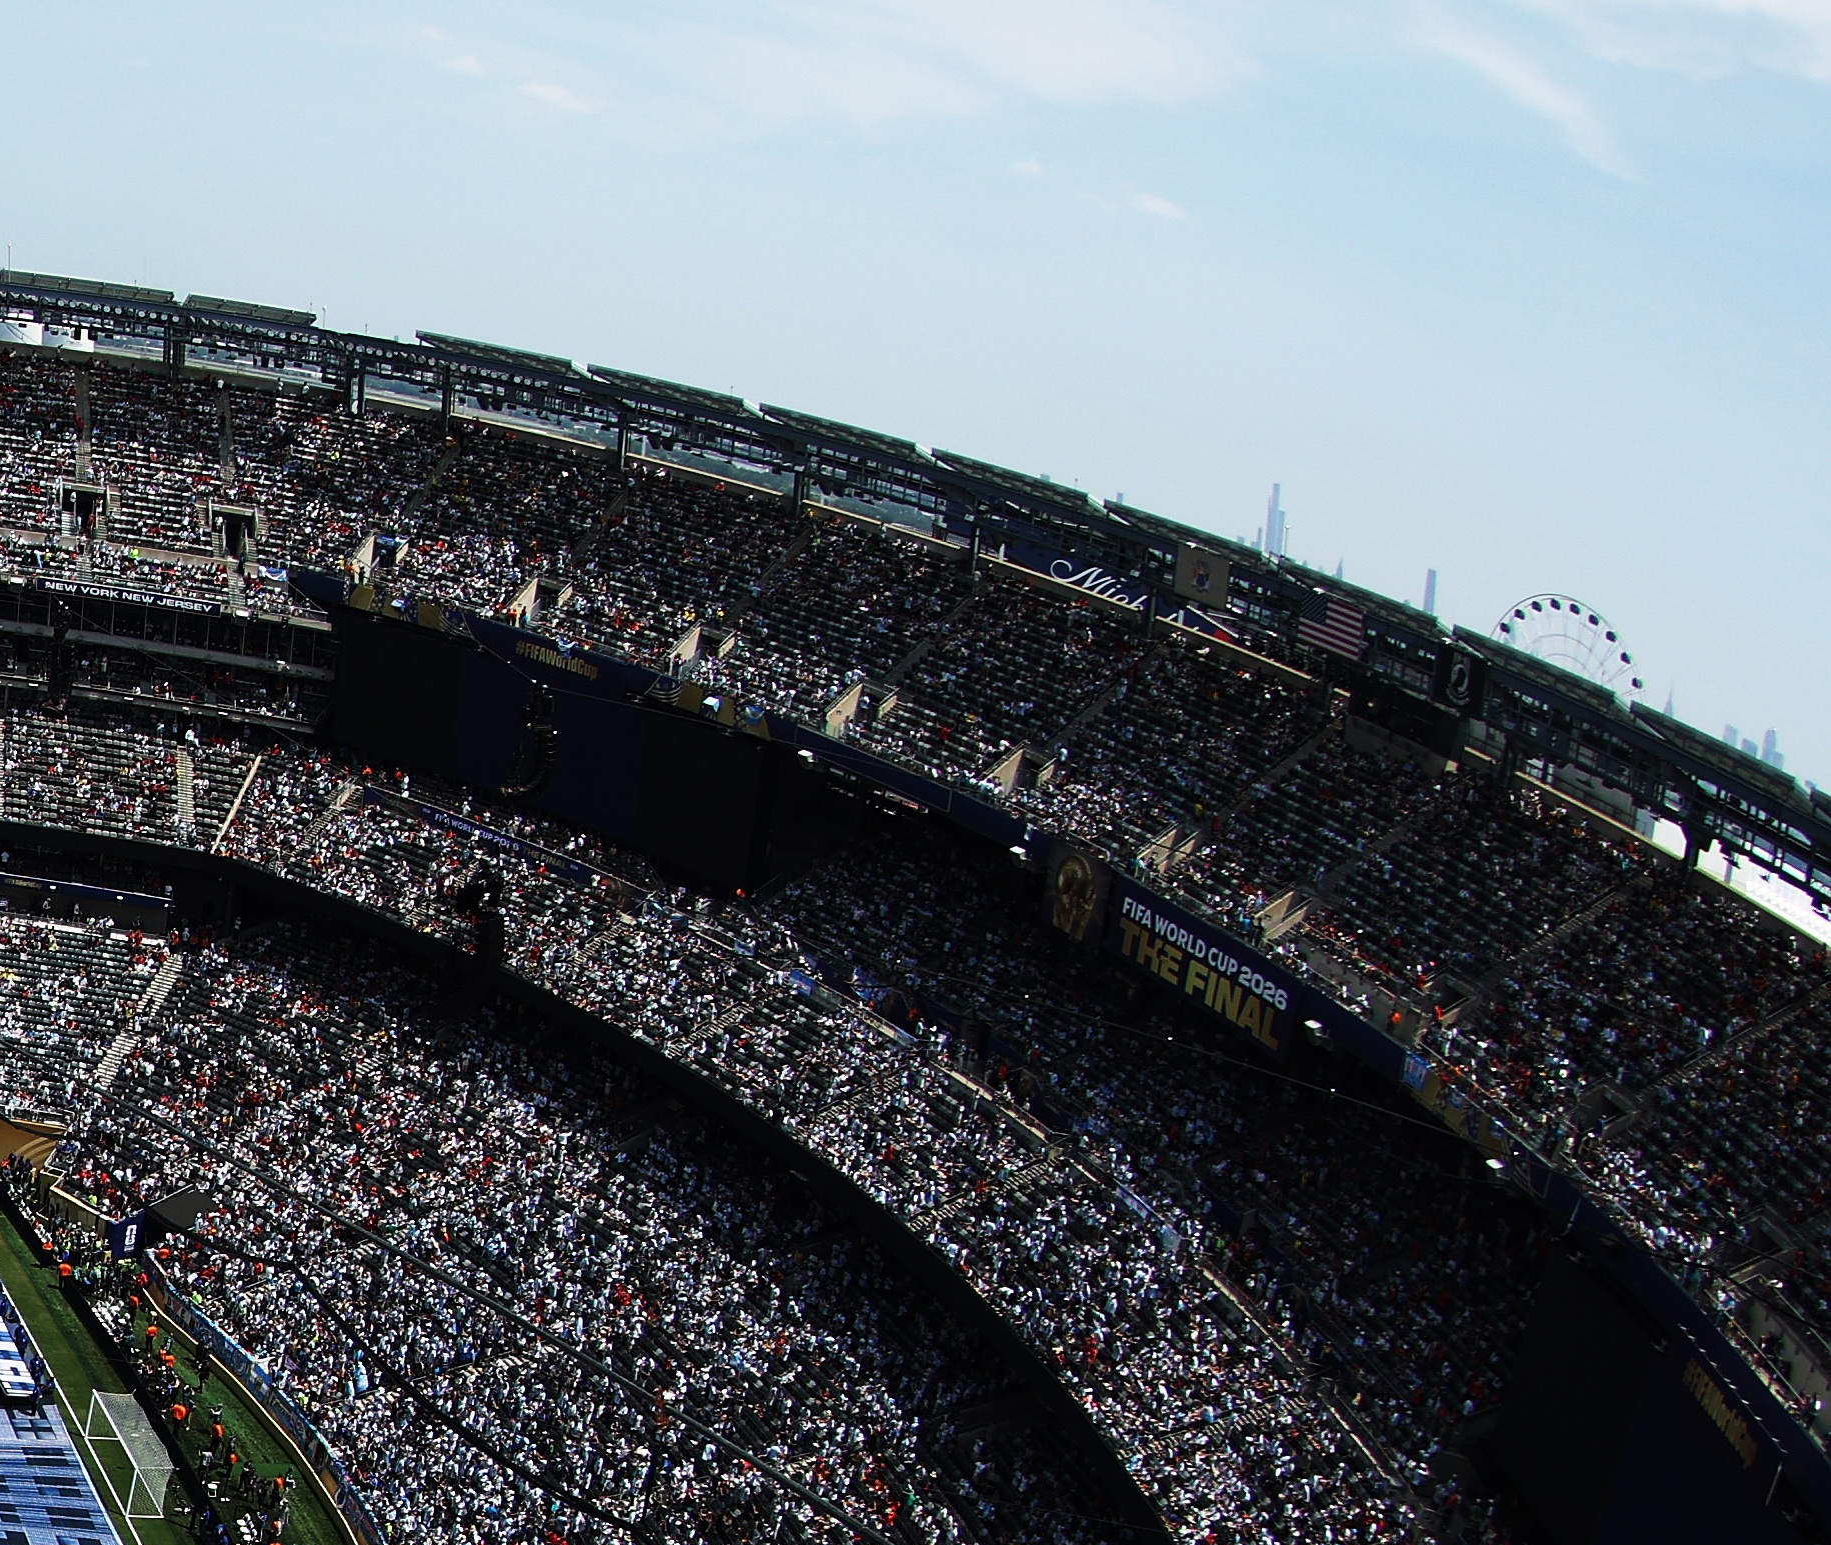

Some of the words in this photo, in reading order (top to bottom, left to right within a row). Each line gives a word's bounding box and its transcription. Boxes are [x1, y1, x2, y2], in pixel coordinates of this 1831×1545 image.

[45, 581, 76, 594] NEW
[80, 585, 119, 599] YORK
[121, 591, 154, 604] NEW
[156, 595, 212, 613] JERSEY
[1120, 917, 1180, 985] THE
[1184, 961, 1281, 1051] FINAL
[1122, 896, 1152, 928] FIFA
[1155, 914, 1206, 958] WORLD
[1208, 944, 1238, 975] CUP
[1238, 963, 1288, 1011] 2026
